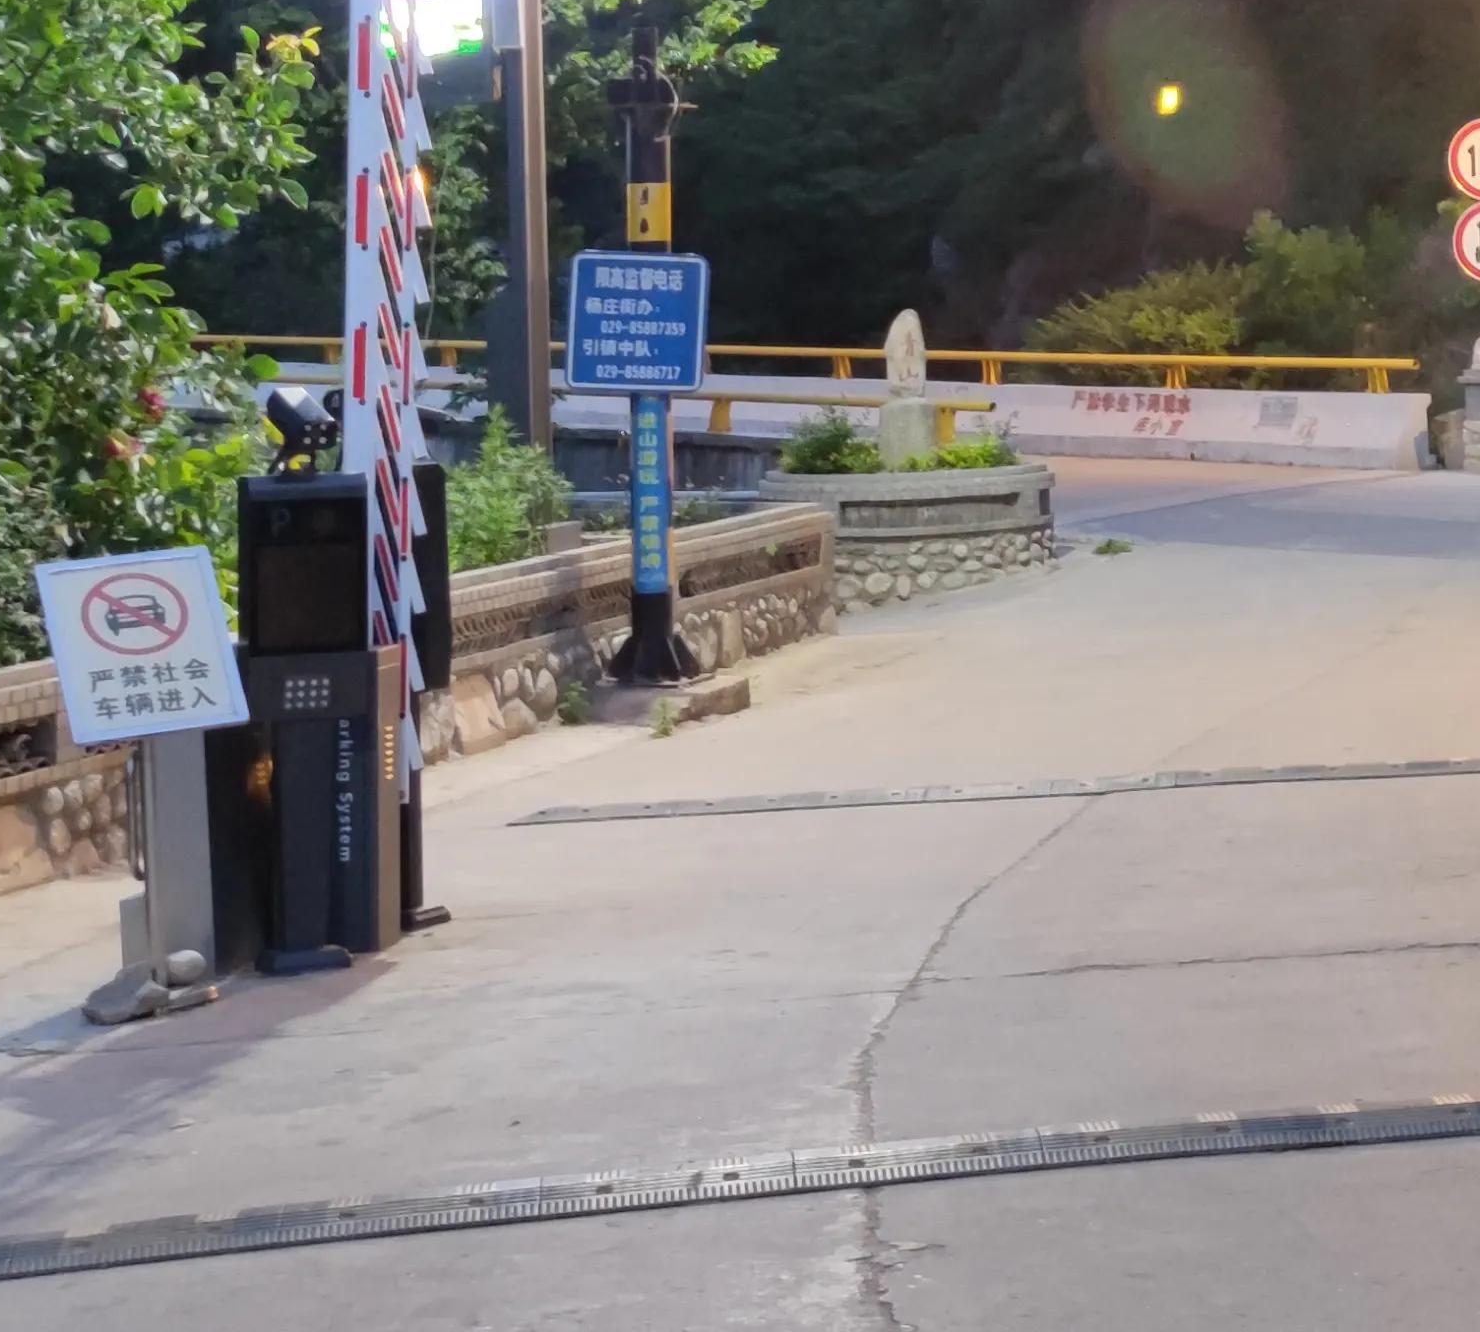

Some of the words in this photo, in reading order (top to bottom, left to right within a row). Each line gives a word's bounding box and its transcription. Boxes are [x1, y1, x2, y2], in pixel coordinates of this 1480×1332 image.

[87, 657, 211, 694] 严禁社会
[93, 686, 218, 720] 车辆进入
[336, 719, 354, 782] arking
[336, 791, 354, 862] System
